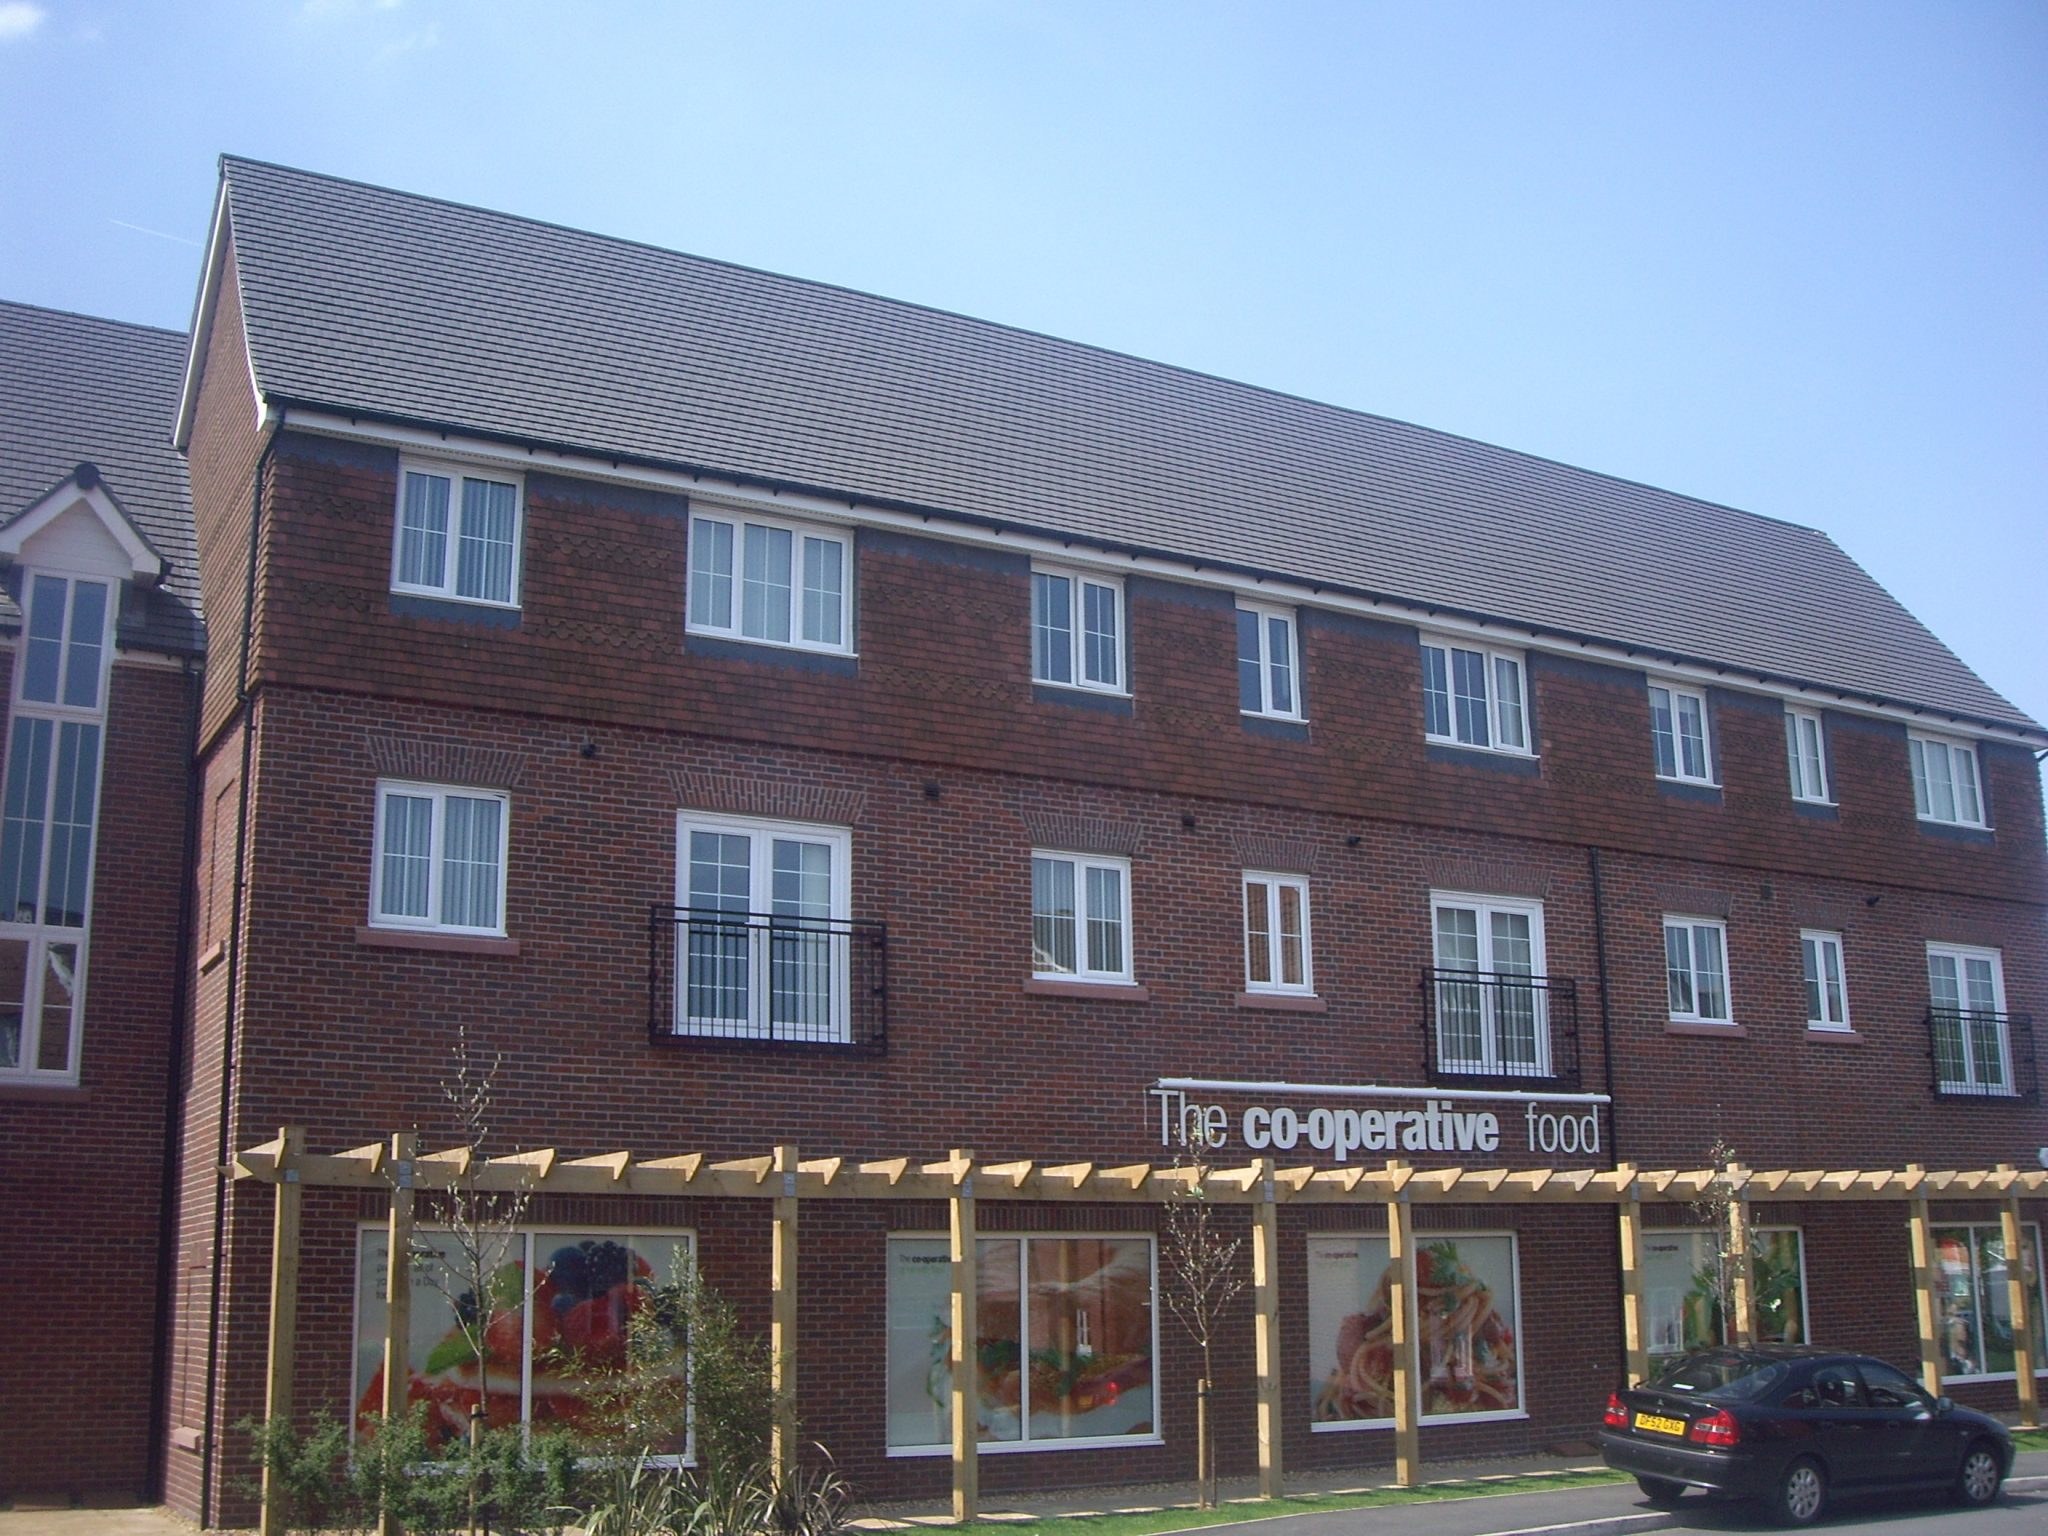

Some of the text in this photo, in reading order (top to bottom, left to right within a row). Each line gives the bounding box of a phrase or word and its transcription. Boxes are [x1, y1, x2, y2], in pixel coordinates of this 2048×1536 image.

[1150, 1089, 1600, 1161] The co-operative food
